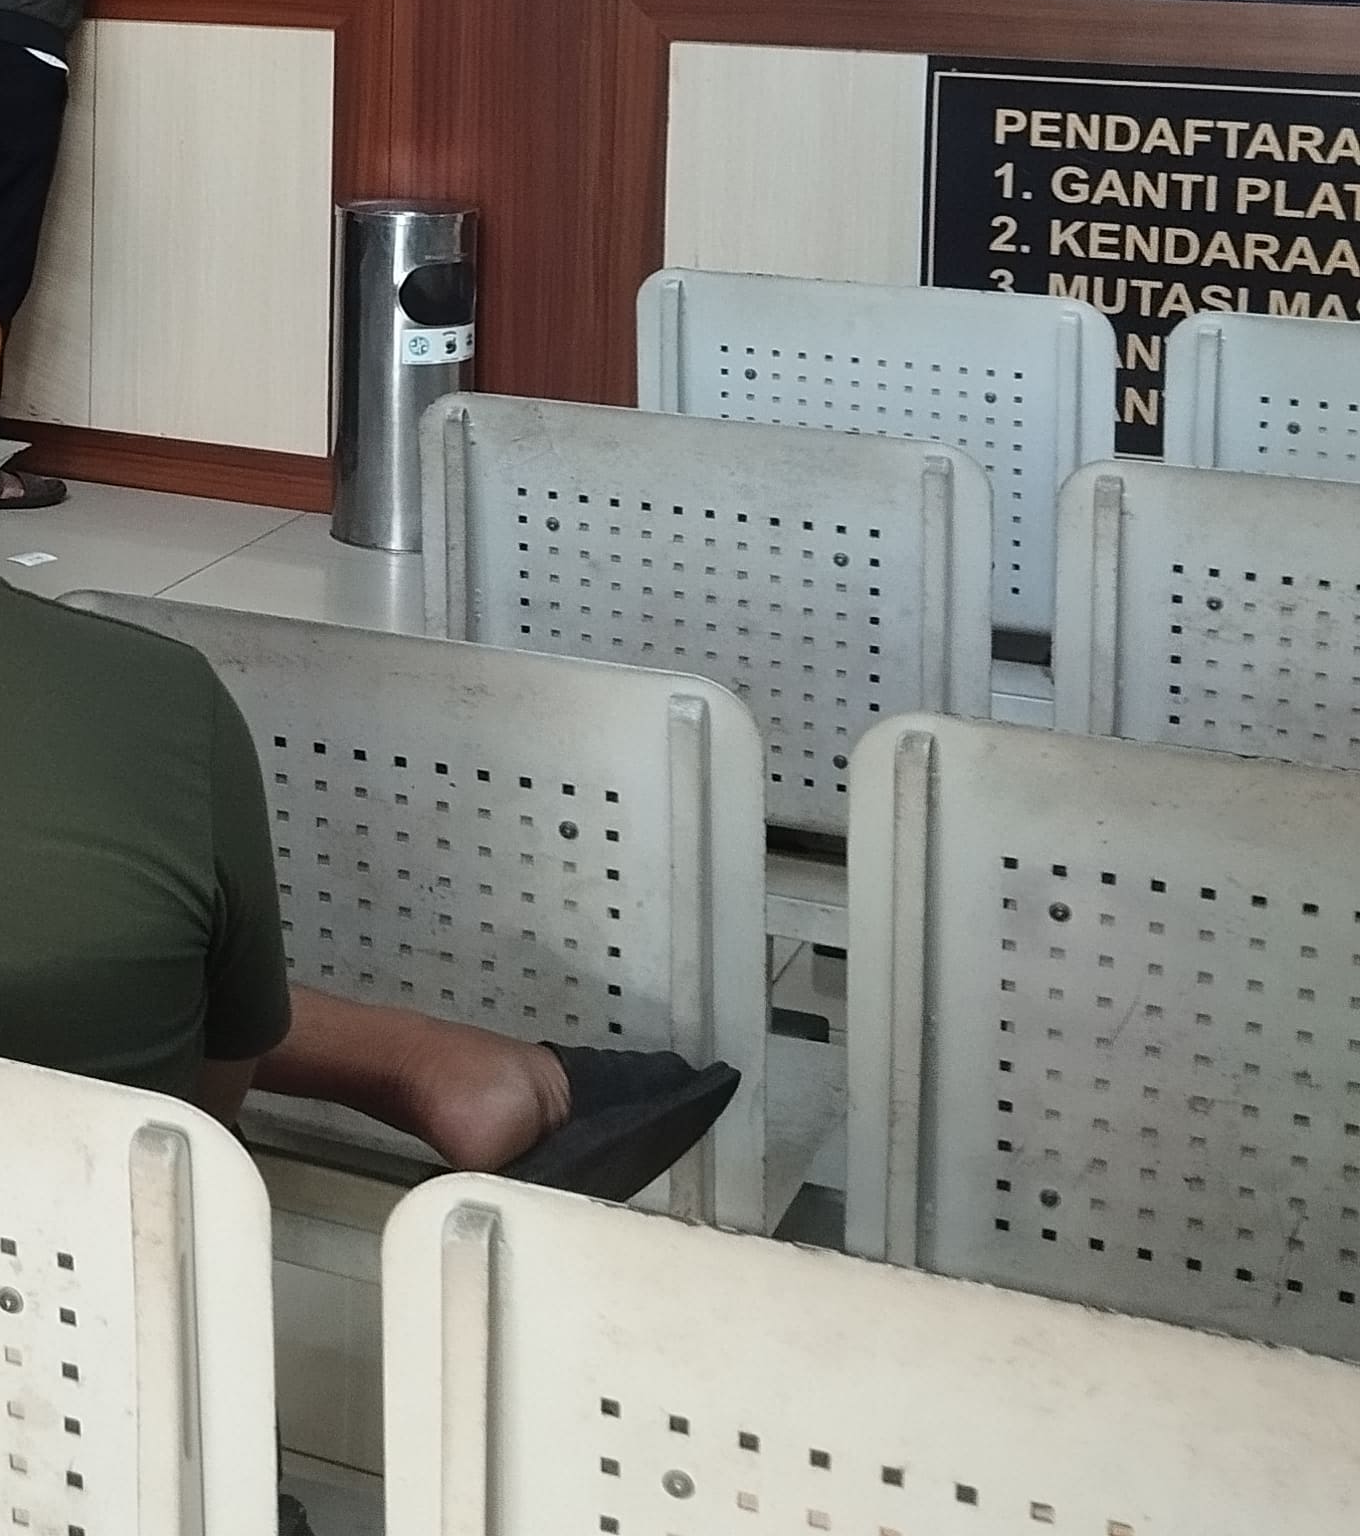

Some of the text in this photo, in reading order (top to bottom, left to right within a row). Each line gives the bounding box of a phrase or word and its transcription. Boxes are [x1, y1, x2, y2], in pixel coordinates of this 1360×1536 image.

[994, 108, 1360, 165] PENDAFTARA
[993, 162, 1032, 199] 1.
[1050, 165, 1218, 213] GANTI
[989, 215, 1360, 278] 2. KENDARAA
[1048, 272, 1251, 319] MUTASI
[1268, 289, 1360, 322] MA
